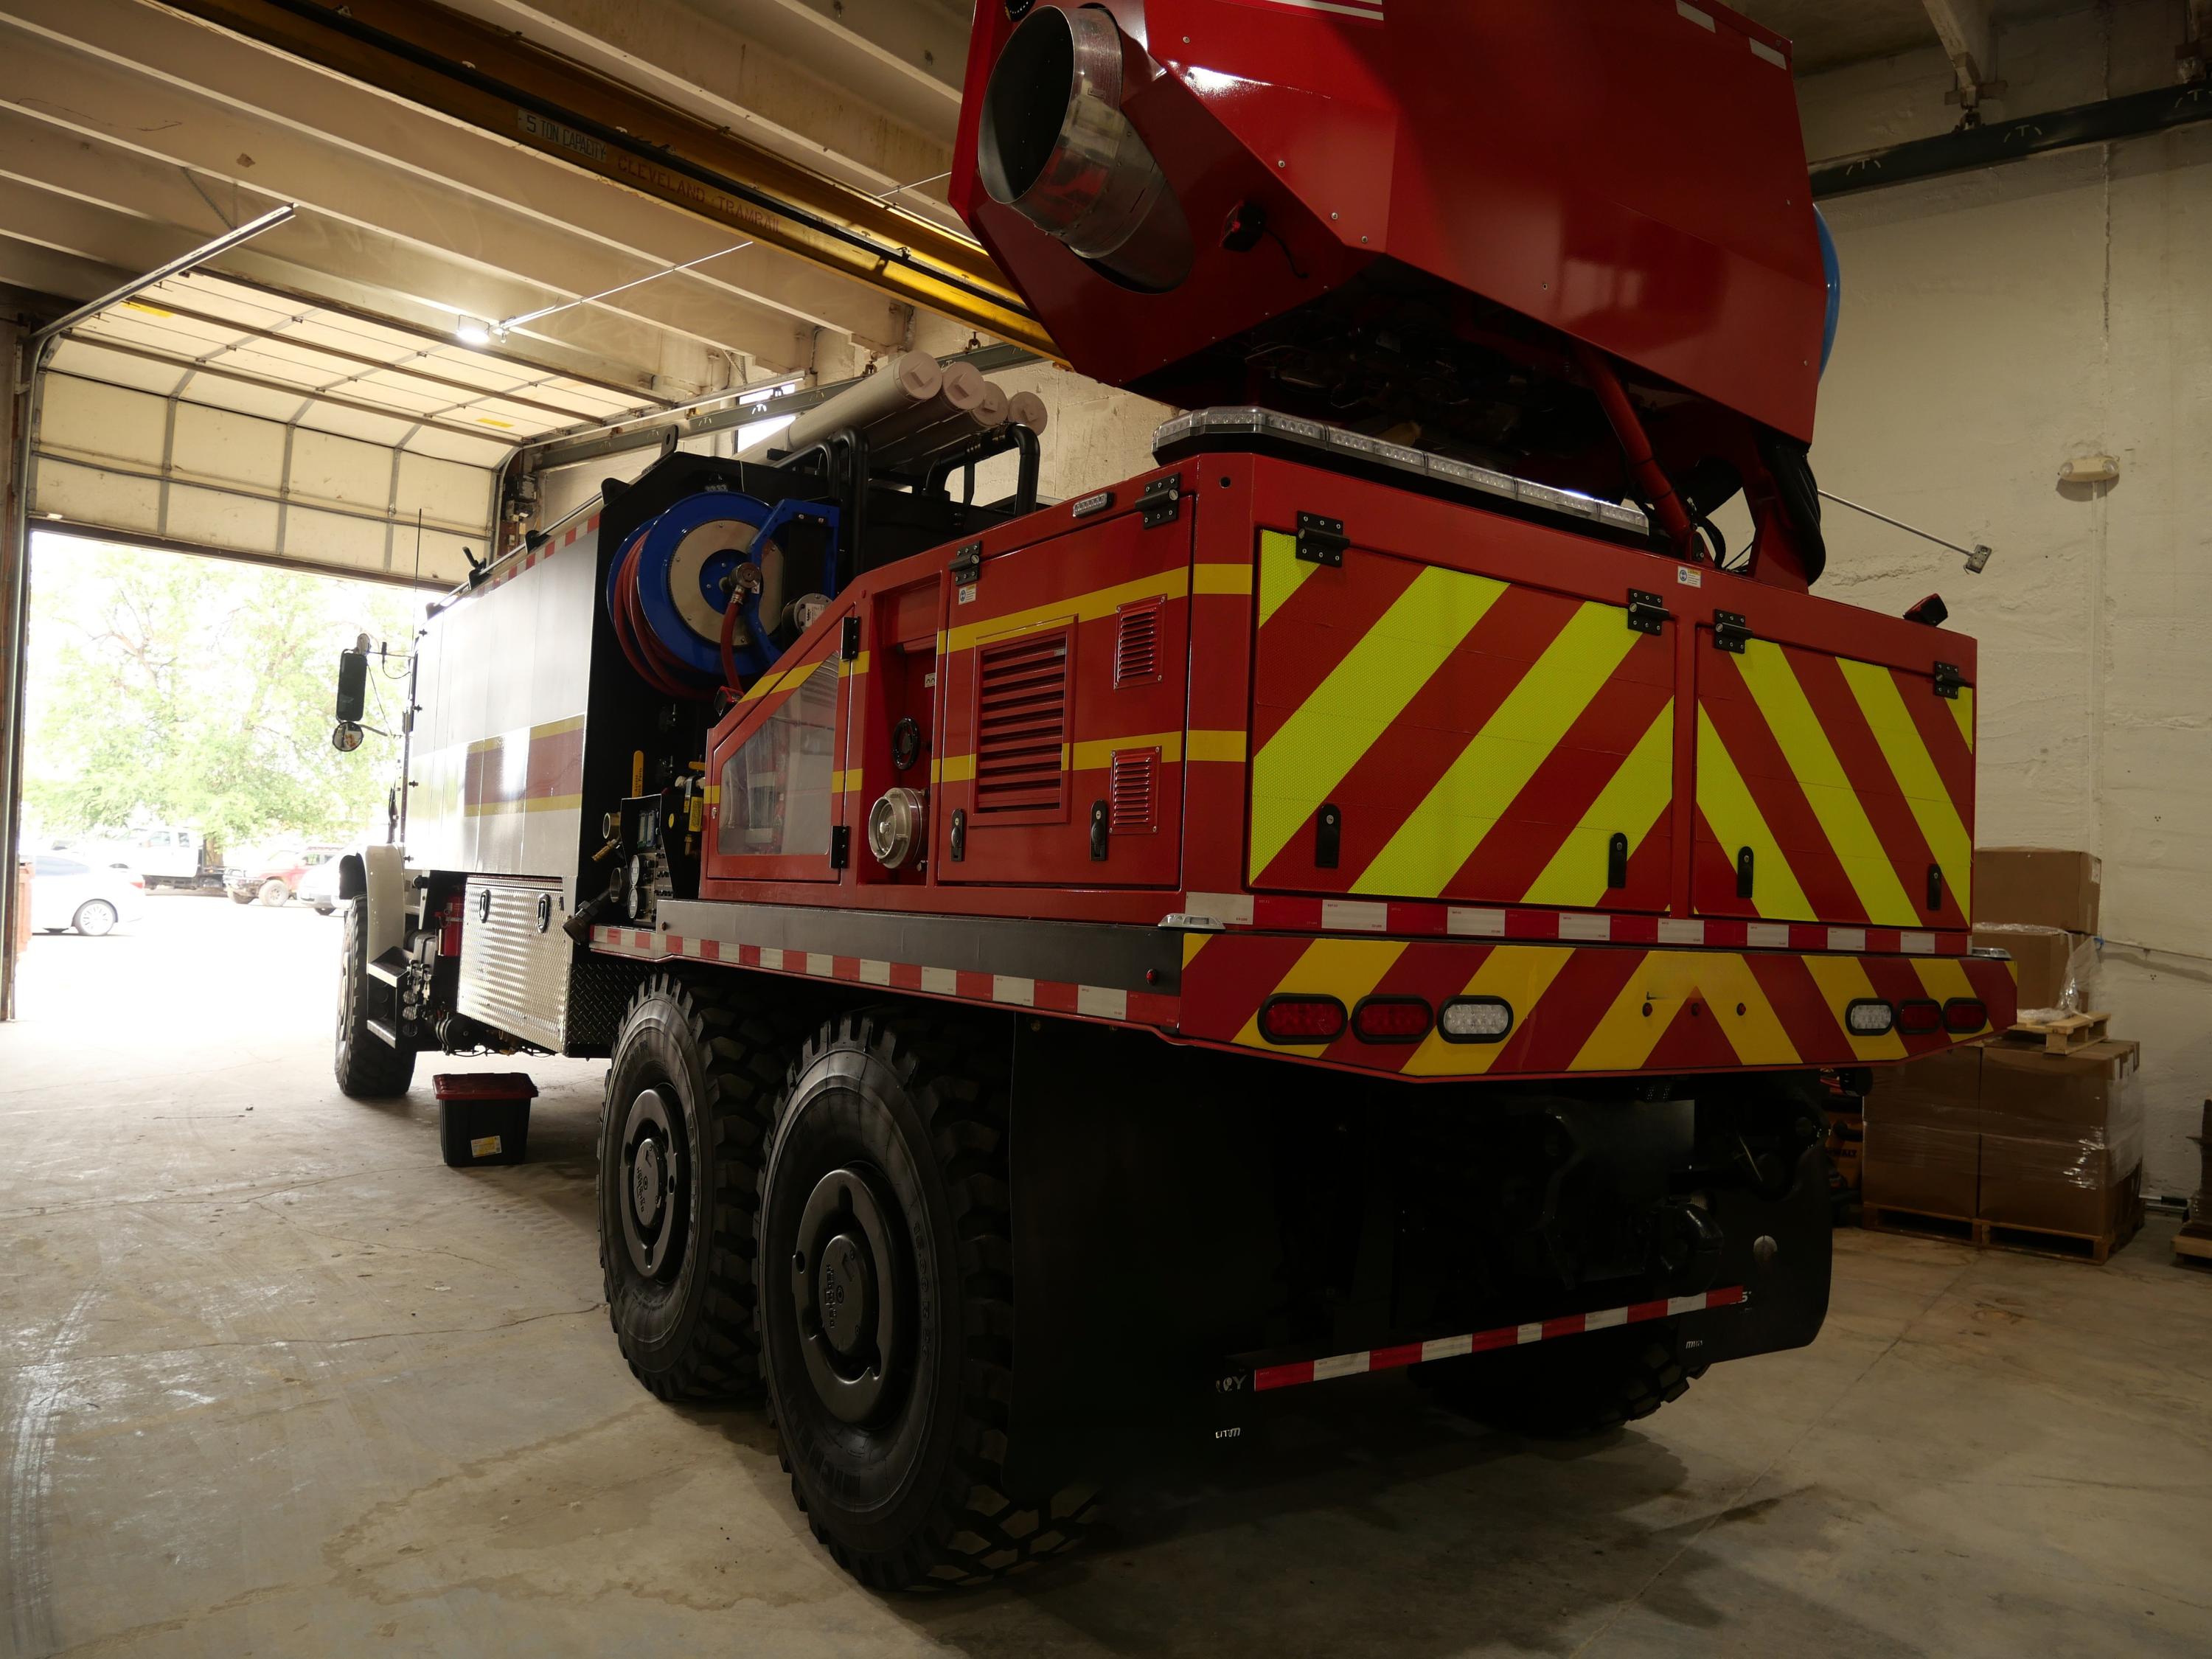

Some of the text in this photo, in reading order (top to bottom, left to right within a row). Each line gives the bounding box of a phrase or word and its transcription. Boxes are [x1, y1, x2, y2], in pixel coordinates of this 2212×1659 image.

[526, 114, 605, 160] 5 TON CAPACITY
[618, 156, 706, 204] CLEVELAND
